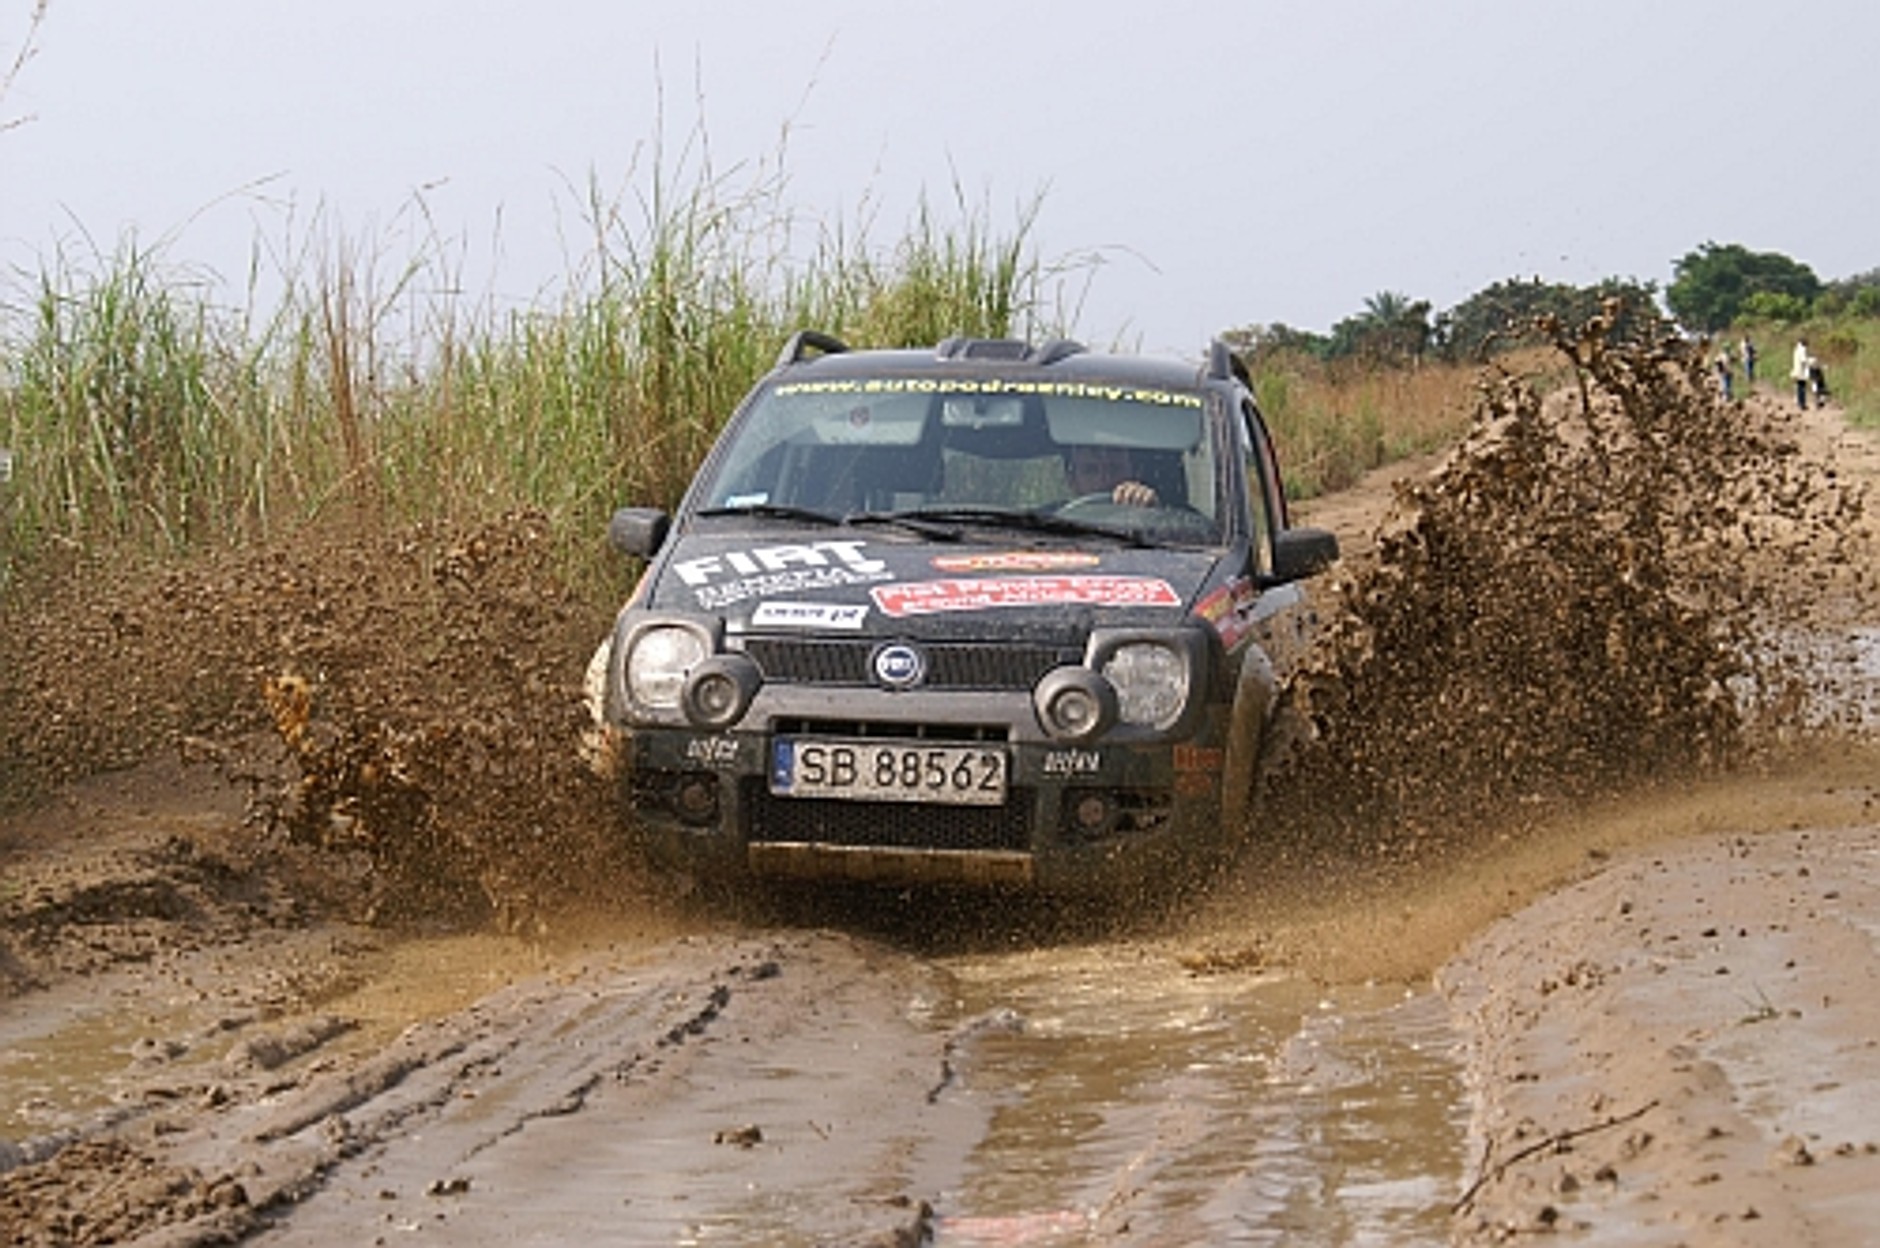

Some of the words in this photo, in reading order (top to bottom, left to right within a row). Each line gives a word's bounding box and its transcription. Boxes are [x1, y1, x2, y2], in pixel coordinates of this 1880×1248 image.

[673, 541, 885, 587] FIAT
[800, 747, 858, 788] SB
[874, 750, 1003, 792] 88562
